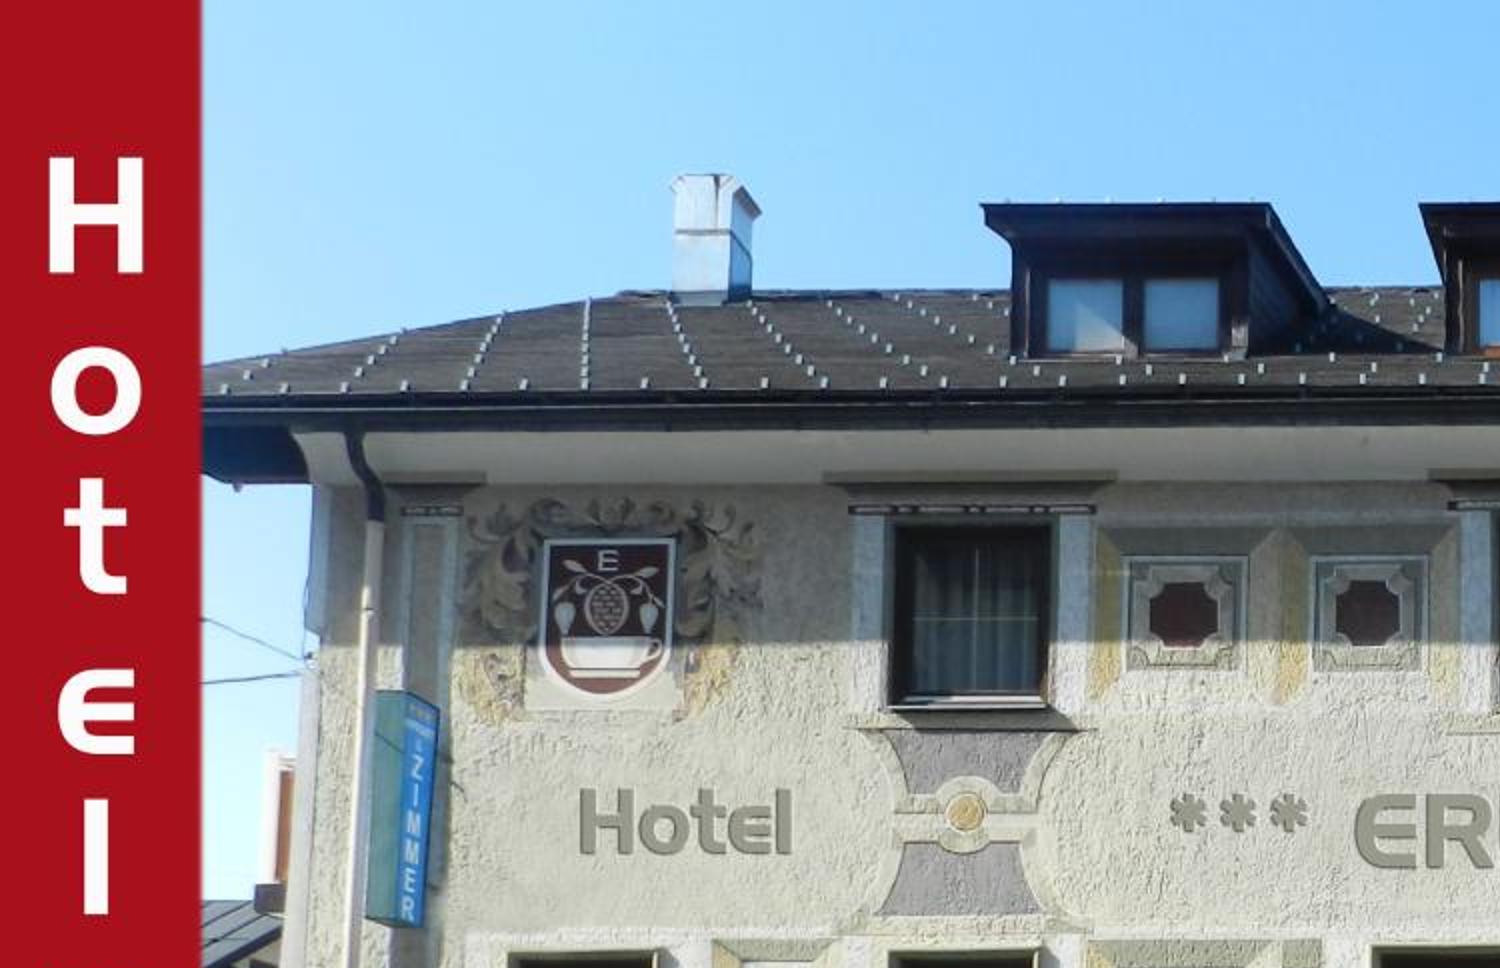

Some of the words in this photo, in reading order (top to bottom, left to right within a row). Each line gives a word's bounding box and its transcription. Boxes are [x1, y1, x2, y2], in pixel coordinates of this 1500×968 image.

[597, 549, 620, 571] E
[400, 753, 425, 922] ZIMMER
[579, 787, 793, 856] Hotel
